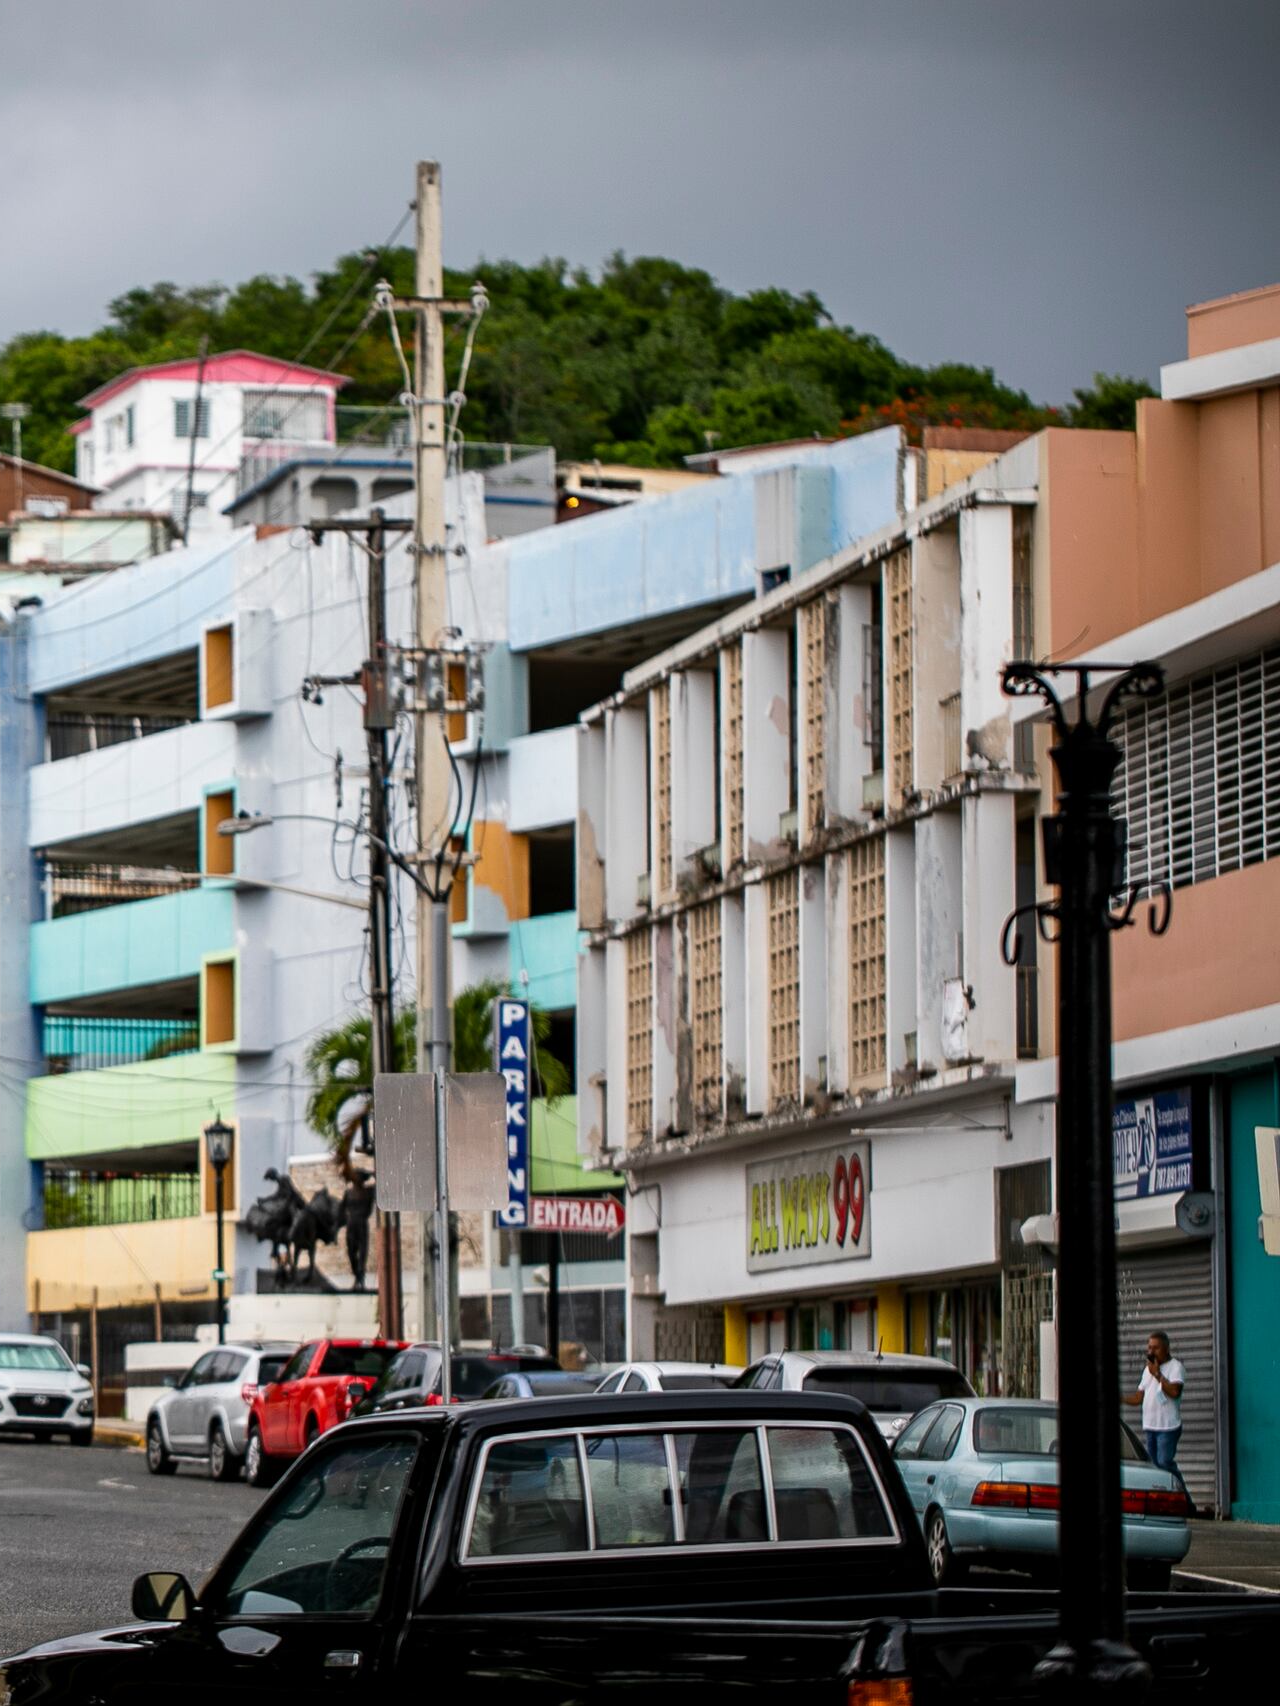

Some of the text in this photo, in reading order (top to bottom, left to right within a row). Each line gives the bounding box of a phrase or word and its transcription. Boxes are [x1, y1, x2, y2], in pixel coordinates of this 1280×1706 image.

[501, 1003, 526, 1225] PARKING
[533, 1200, 619, 1229] ENTRADA
[750, 1151, 865, 1256] ALL WAYS 99
